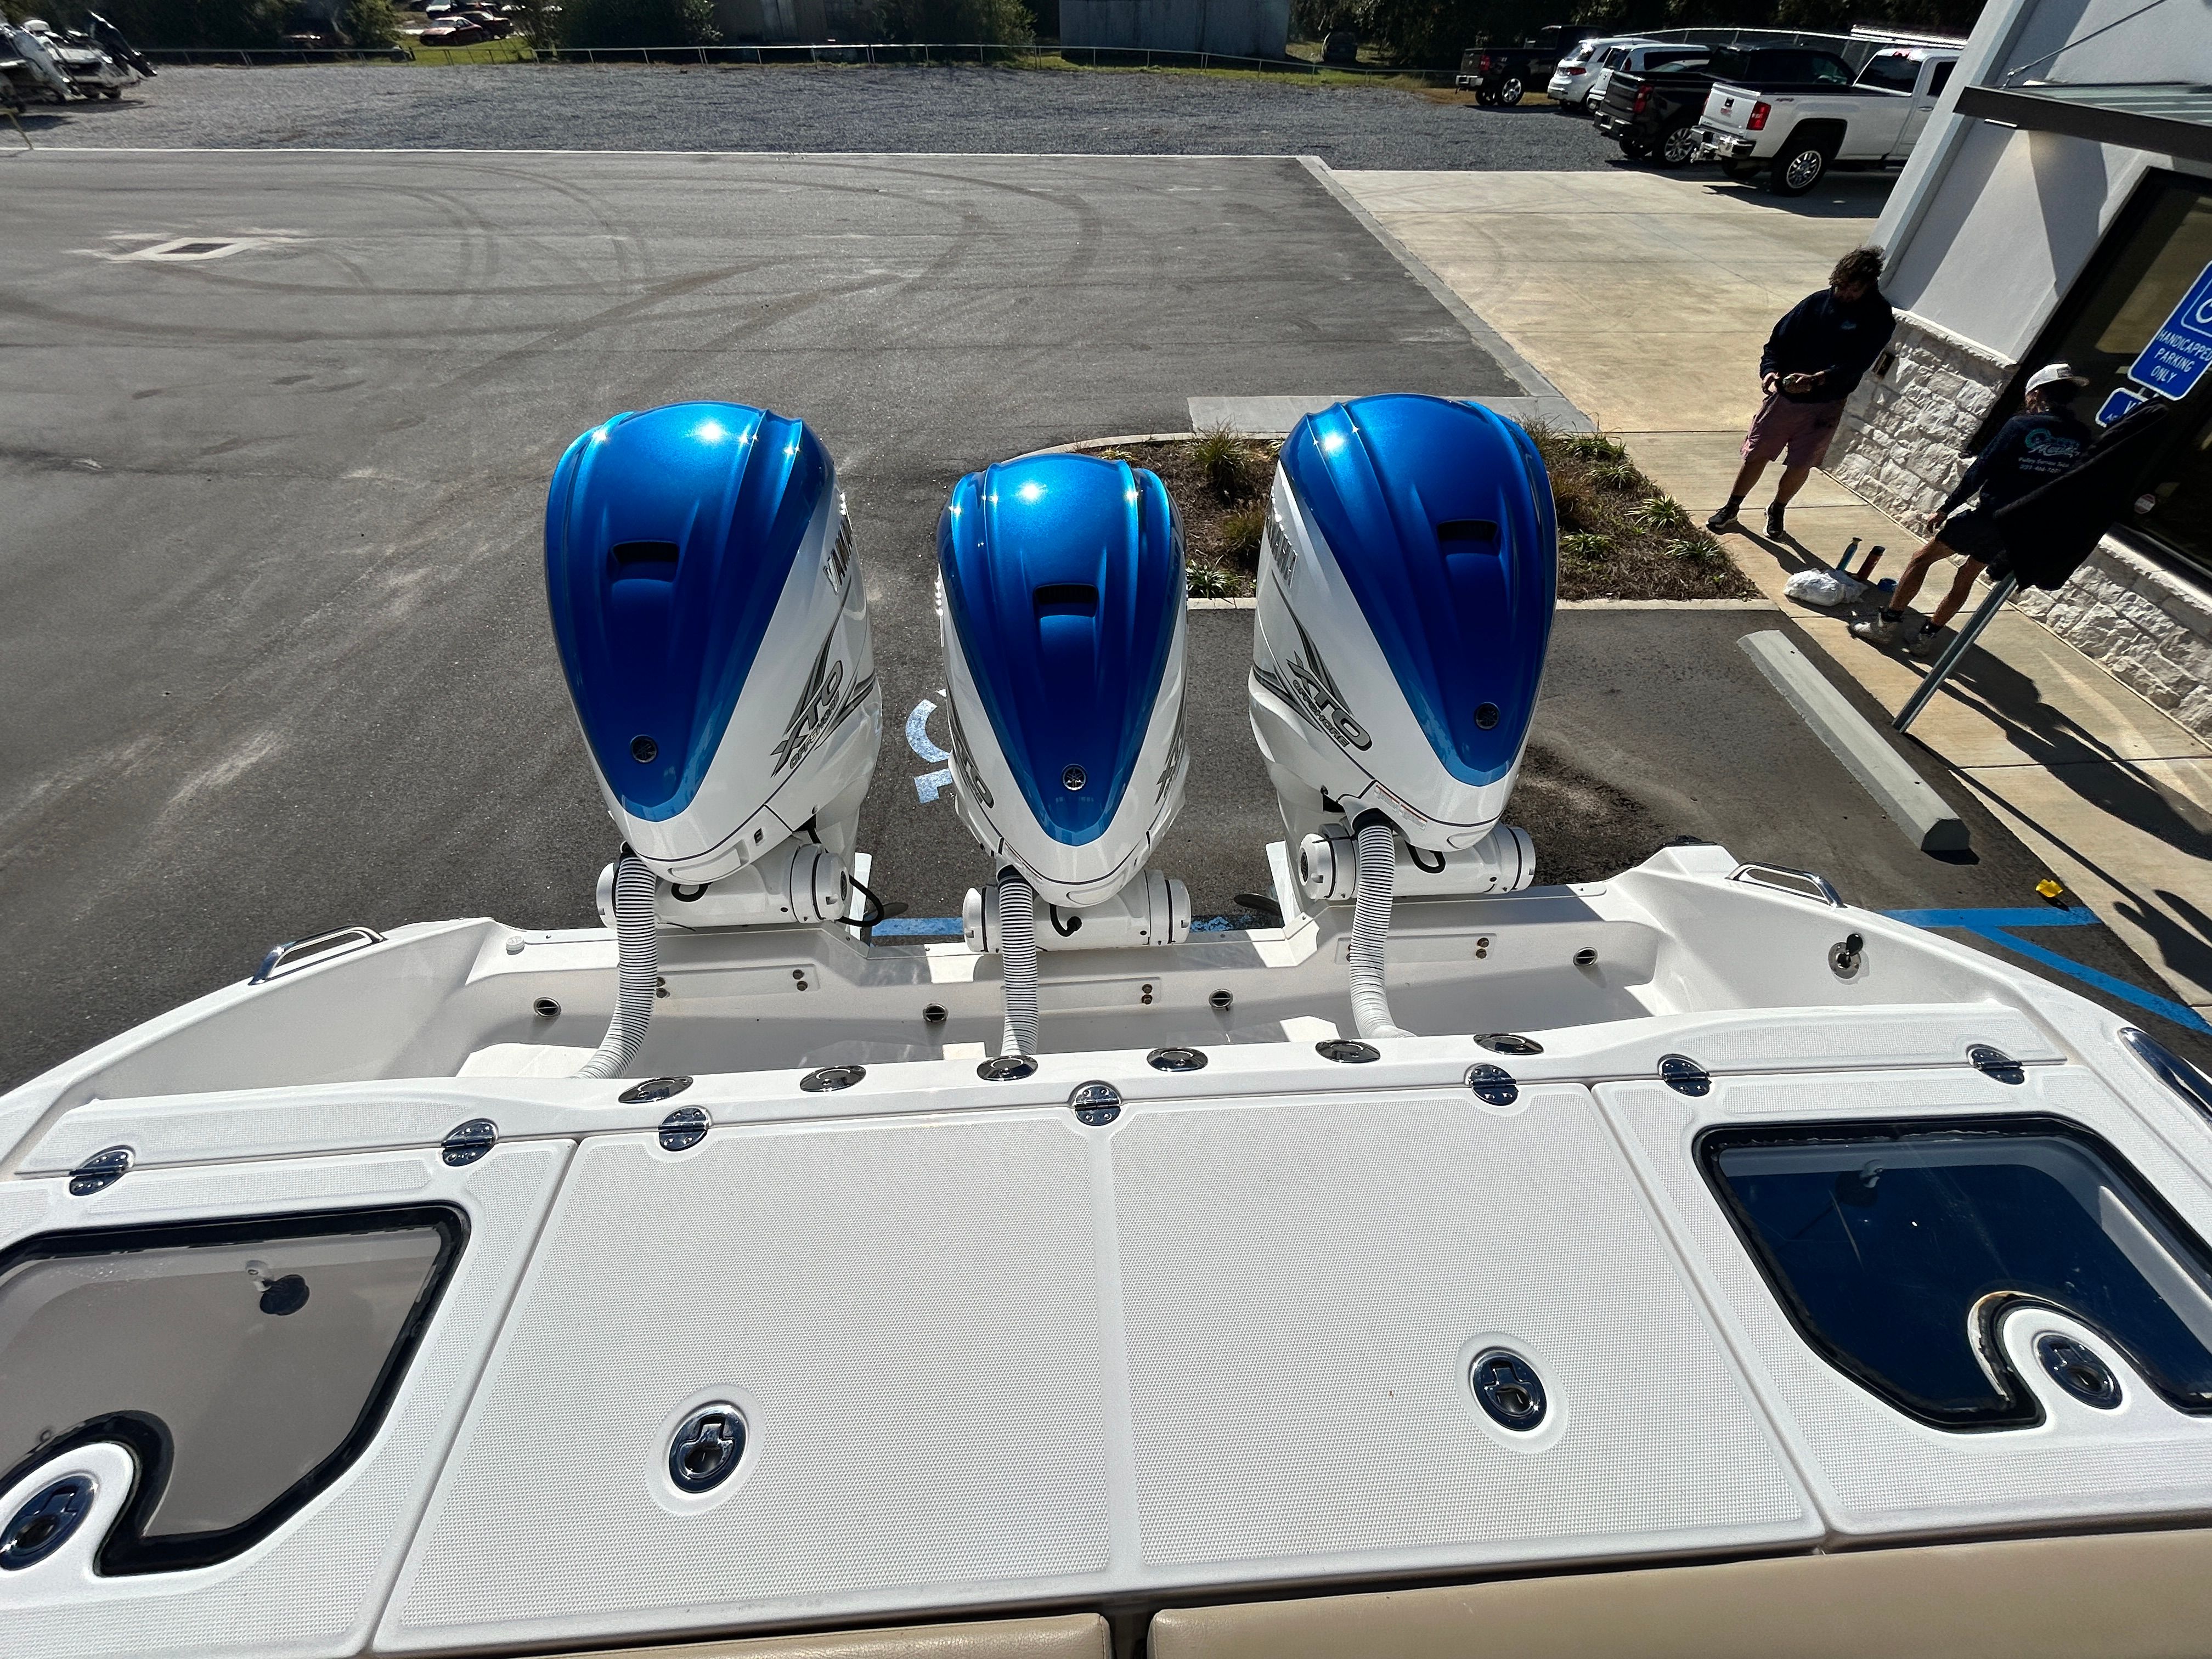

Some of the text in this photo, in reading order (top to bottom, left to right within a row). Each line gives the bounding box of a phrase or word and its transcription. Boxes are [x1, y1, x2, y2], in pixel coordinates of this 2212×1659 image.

[2150, 365, 2177, 383] ONLY
[2154, 347, 2195, 373] PARKING
[770, 660, 844, 778] XTO
[790, 690, 840, 769] OFFSHORE
[1286, 650, 1373, 752] XTO
[1293, 679, 1350, 747] OFFSHORE
